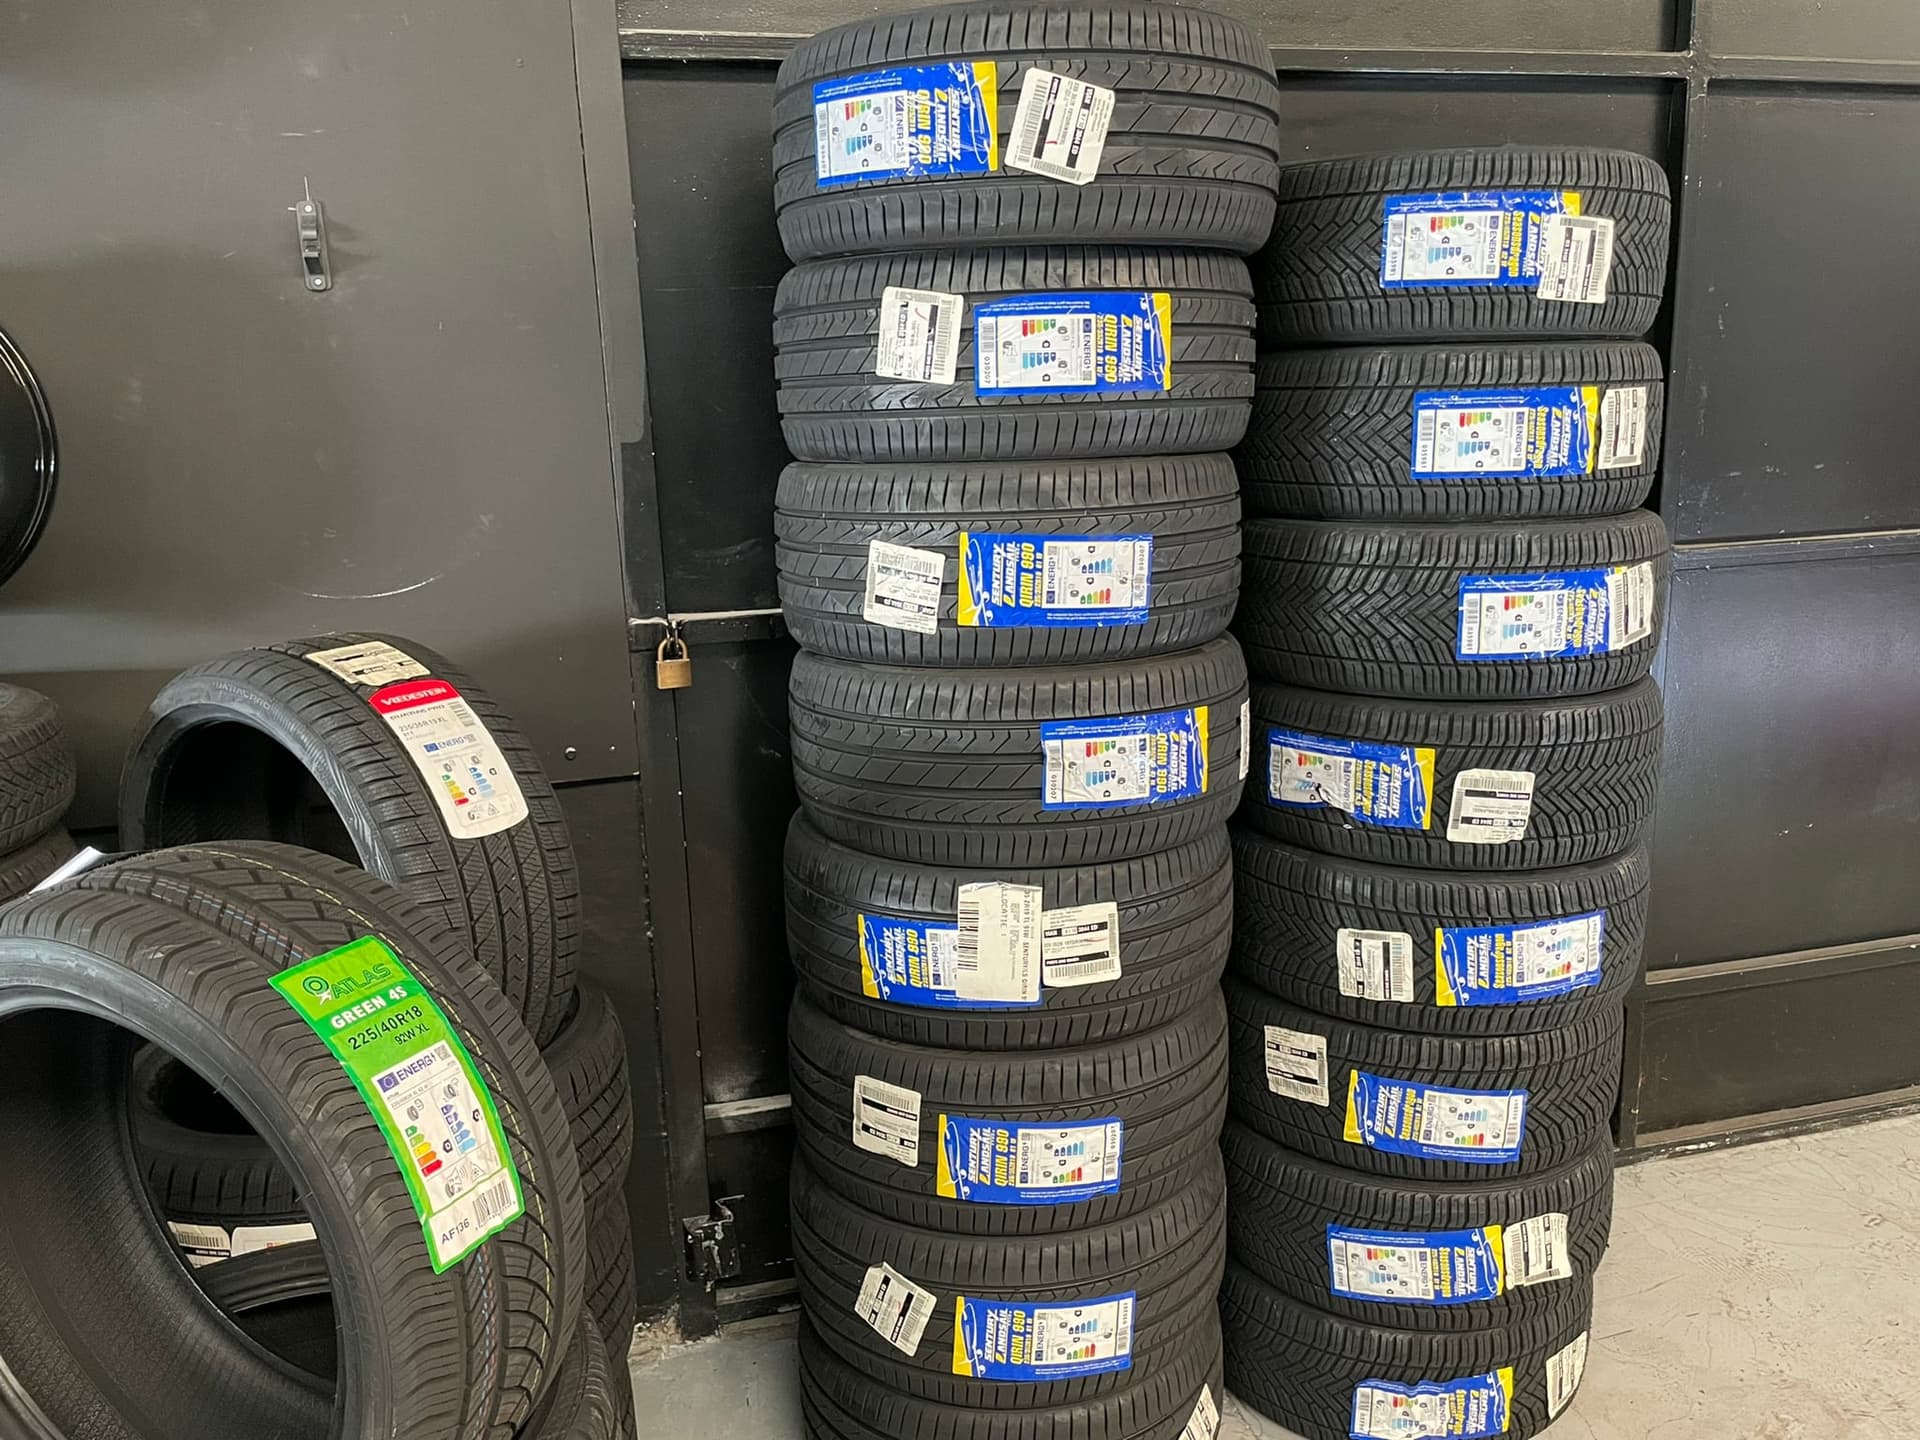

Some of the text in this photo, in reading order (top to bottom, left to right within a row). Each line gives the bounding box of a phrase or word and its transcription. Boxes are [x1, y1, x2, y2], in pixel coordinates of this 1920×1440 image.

[935, 87, 948, 164] LANDSAIL
[949, 89, 961, 160] SENTURY
[1525, 211, 1540, 277] LANDSAIL
[1104, 315, 1117, 382] QIRIN 990
[1121, 314, 1131, 383] LANDSAIL
[1134, 315, 1142, 380] SENTURY
[1548, 407, 1562, 468] LANDSAIL
[1559, 406, 1571, 465] SENTURY
[992, 543, 1002, 605] SENTURY
[1004, 541, 1015, 606] LANDSAIL
[1020, 542, 1034, 607] QIRIN 990
[1169, 732, 1178, 792] LANDSAIL
[1377, 762, 1391, 818] LANDSAIL
[1388, 765, 1402, 818] SENTURY
[330, 960, 391, 998] ATLAS
[906, 929, 921, 987] QIRIN 990
[1466, 936, 1476, 988] SENTURY
[1478, 934, 1489, 988] LANDSAIL
[330, 984, 407, 1030] GREEN 4S
[347, 1004, 423, 1050] 225/40R18
[394, 1021, 429, 1045] 92W XL
[1373, 1085, 1388, 1133] SENTURY
[1384, 1085, 1399, 1137] LANDSAIL
[968, 1127, 979, 1182] SENTURY
[979, 1126, 991, 1184] LANDSAIL
[994, 1128, 1008, 1186] QIRIN 990
[439, 1218, 470, 1244] AF136
[1454, 1247, 1465, 1296] LANDSAIL
[1466, 1246, 1476, 1293] SENTURY
[984, 1309, 995, 1360] SENTURY
[995, 1308, 1007, 1363] LANDSAIL
[1010, 1310, 1025, 1364] QIRIN 990
